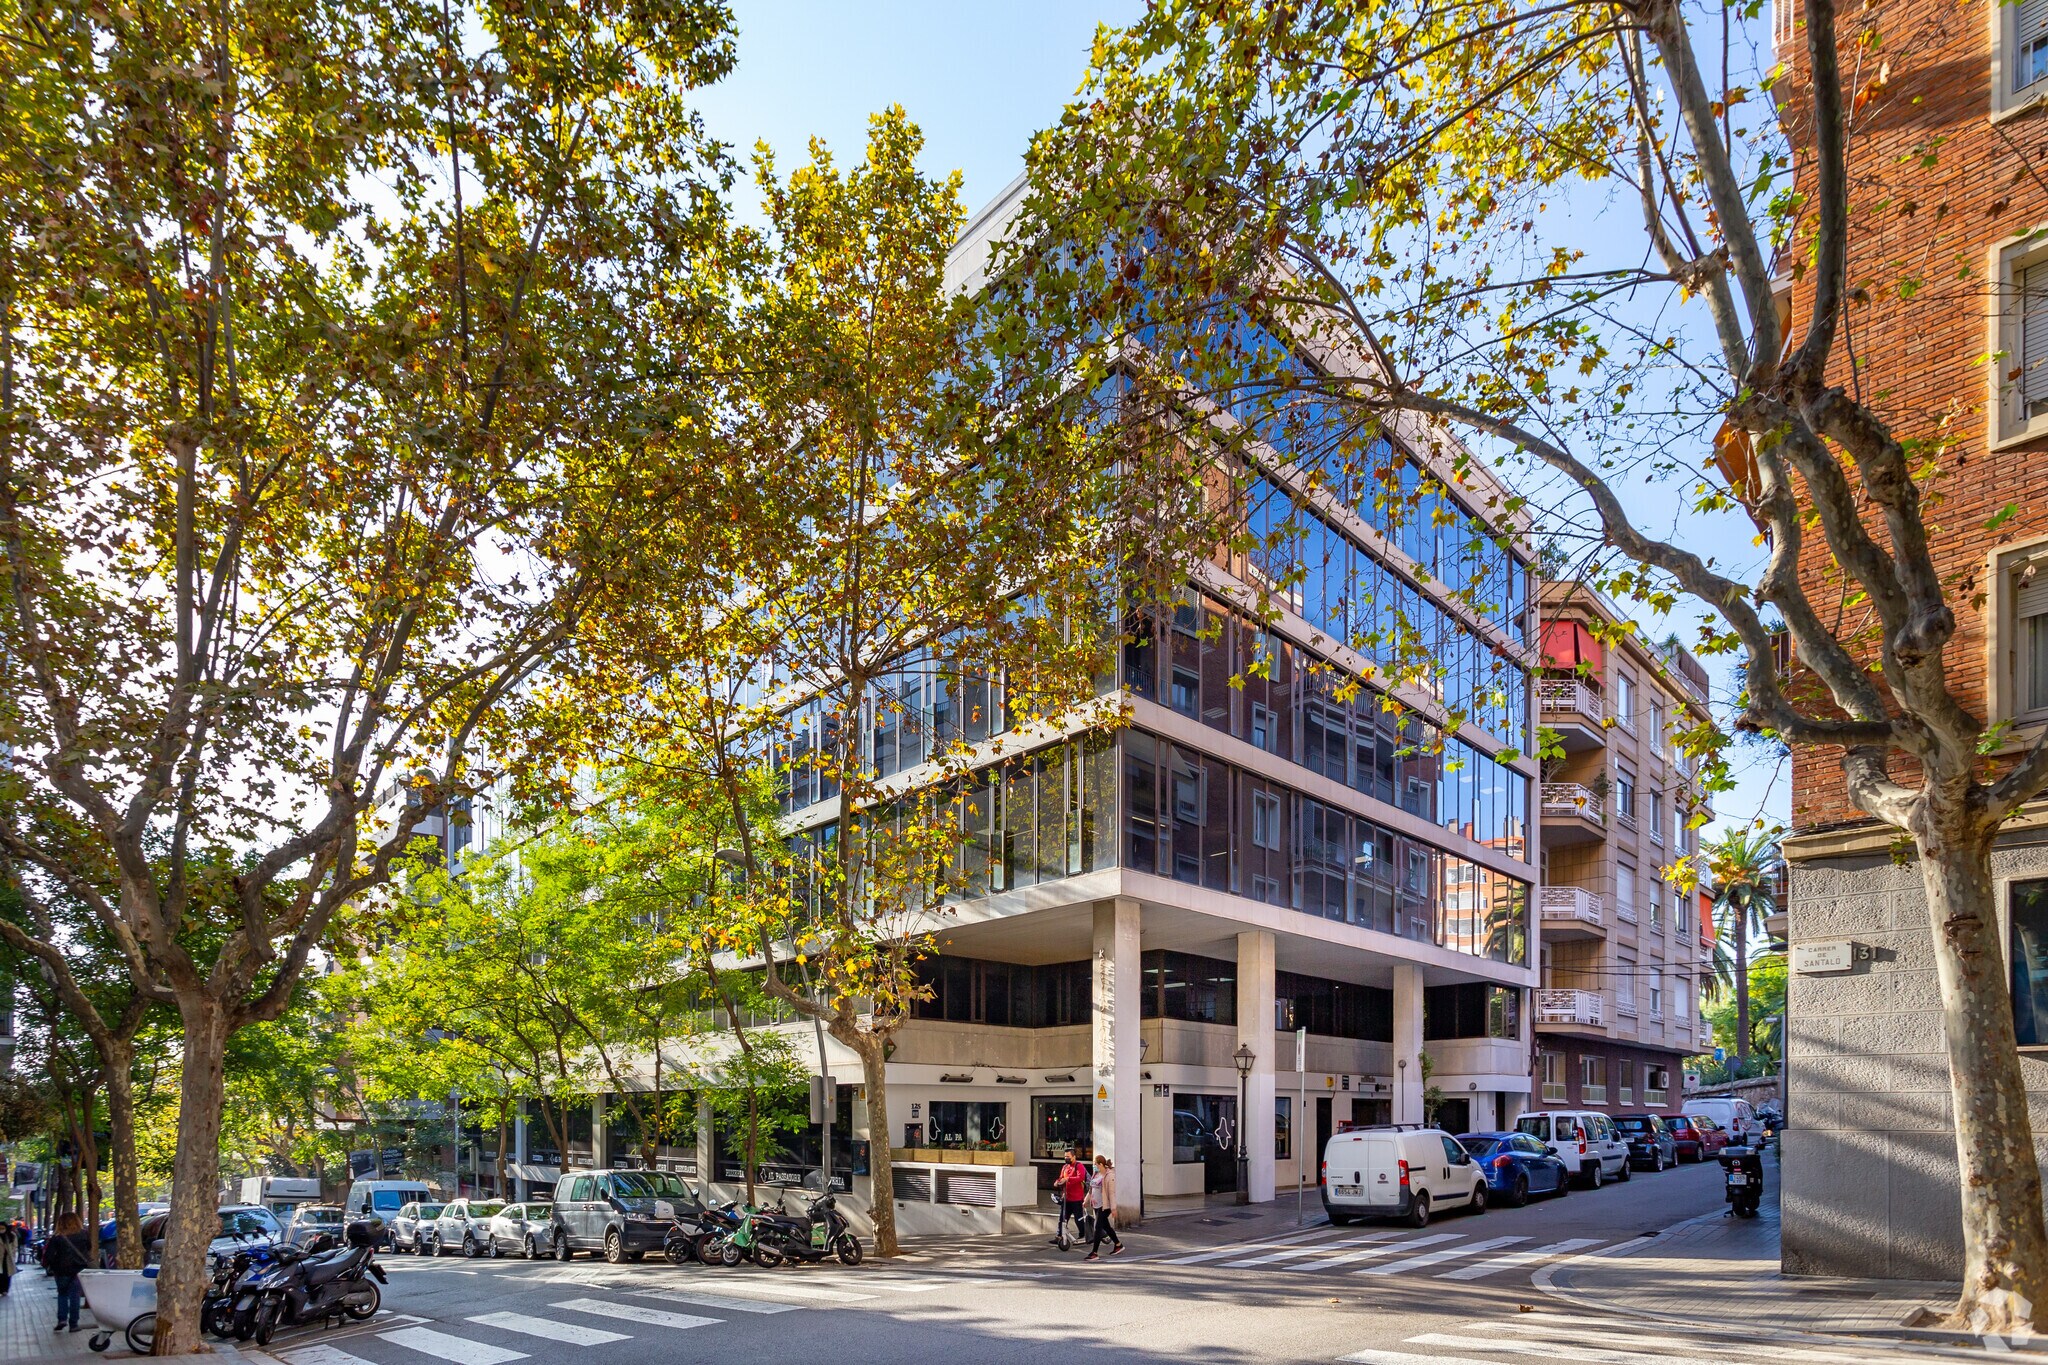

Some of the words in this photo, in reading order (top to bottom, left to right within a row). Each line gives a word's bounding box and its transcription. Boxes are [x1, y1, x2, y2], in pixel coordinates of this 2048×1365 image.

[1853, 946, 1877, 960] 131
[1804, 956, 1840, 967] SANTALÓ
[944, 1133, 952, 1141] AL
